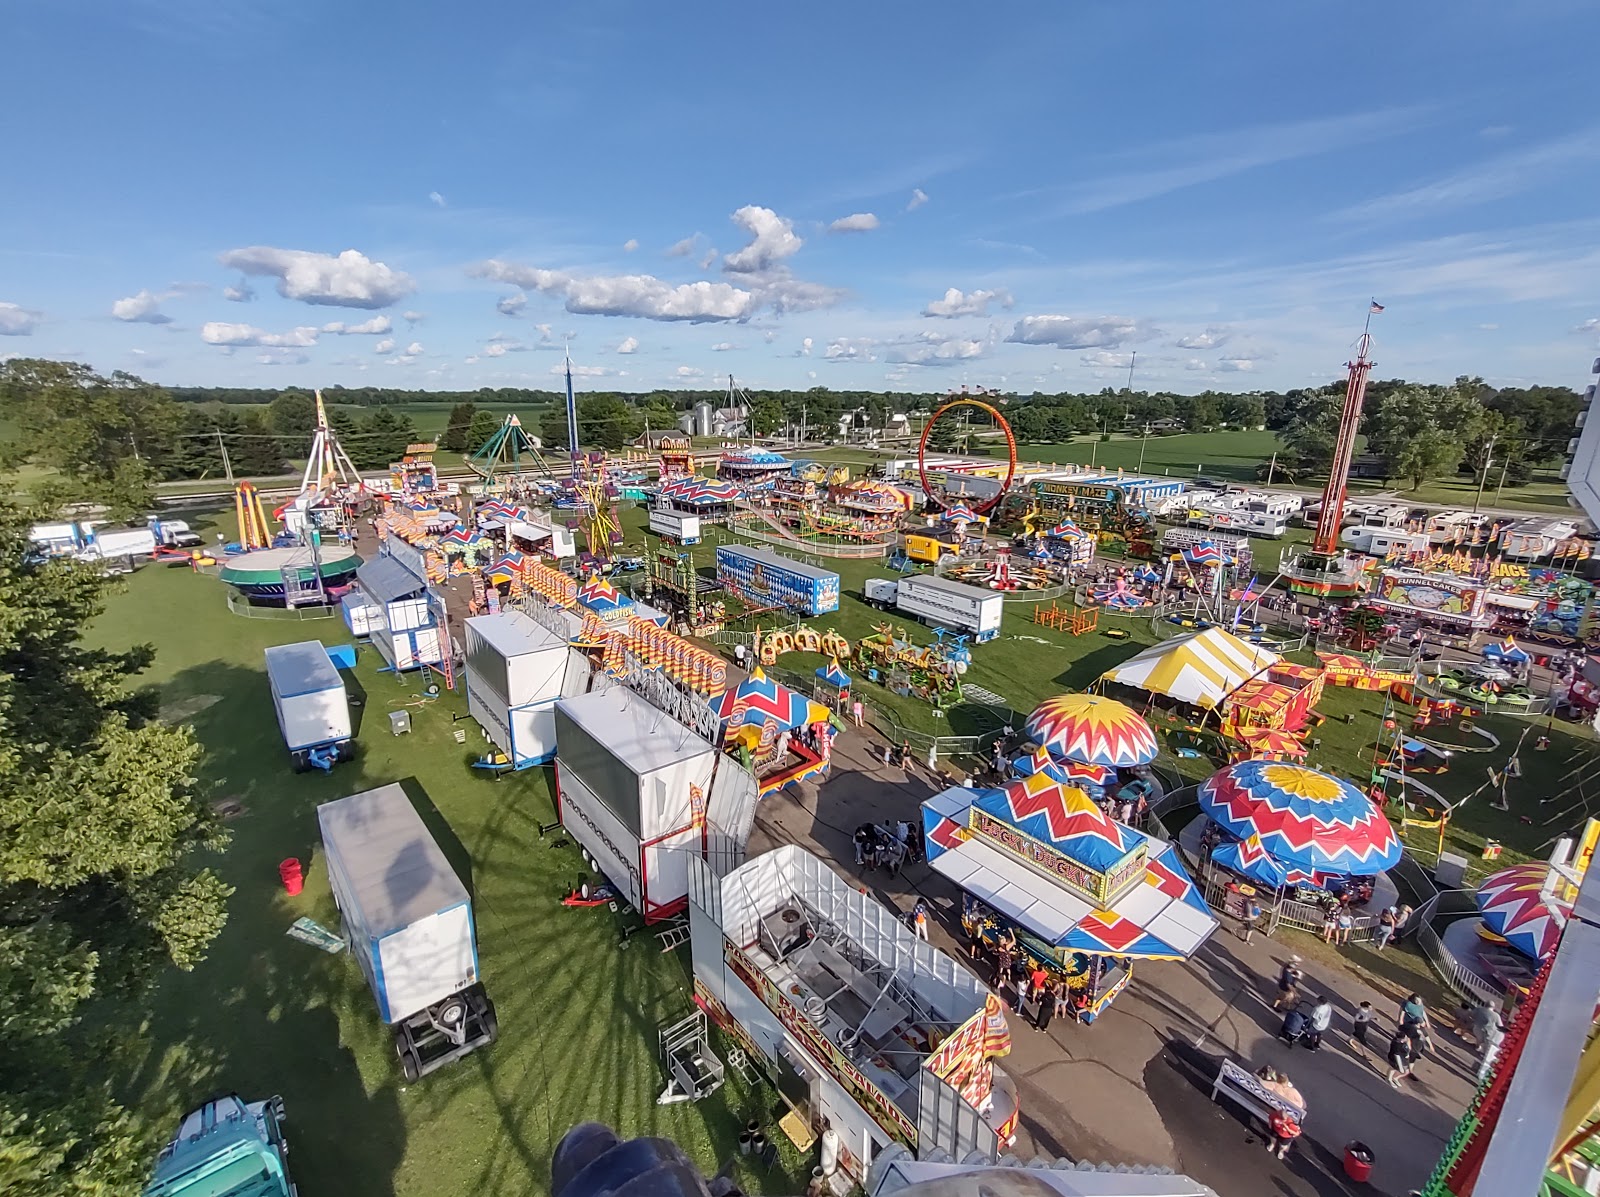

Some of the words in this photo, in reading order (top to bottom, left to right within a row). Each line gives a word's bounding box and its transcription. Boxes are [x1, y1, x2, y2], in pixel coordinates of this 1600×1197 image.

[1043, 483, 1079, 495] MONKEY
[1081, 486, 1107, 497] MAZE
[1397, 578, 1432, 587] FUNNEL
[1432, 581, 1462, 595] CAKES
[604, 607, 634, 621] GOLDFISH
[1387, 605, 1417, 615] TWINKIES
[861, 638, 885, 652] DINO
[897, 650, 929, 669] TRAIN
[1325, 667, 1366, 677] ANIMALS
[980, 814, 1030, 855] LUCKY
[1032, 841, 1090, 888] DUCKY
[725, 938, 771, 993] PASTA
[779, 993, 835, 1059] PIZZA
[841, 1059, 916, 1141] SALADS
